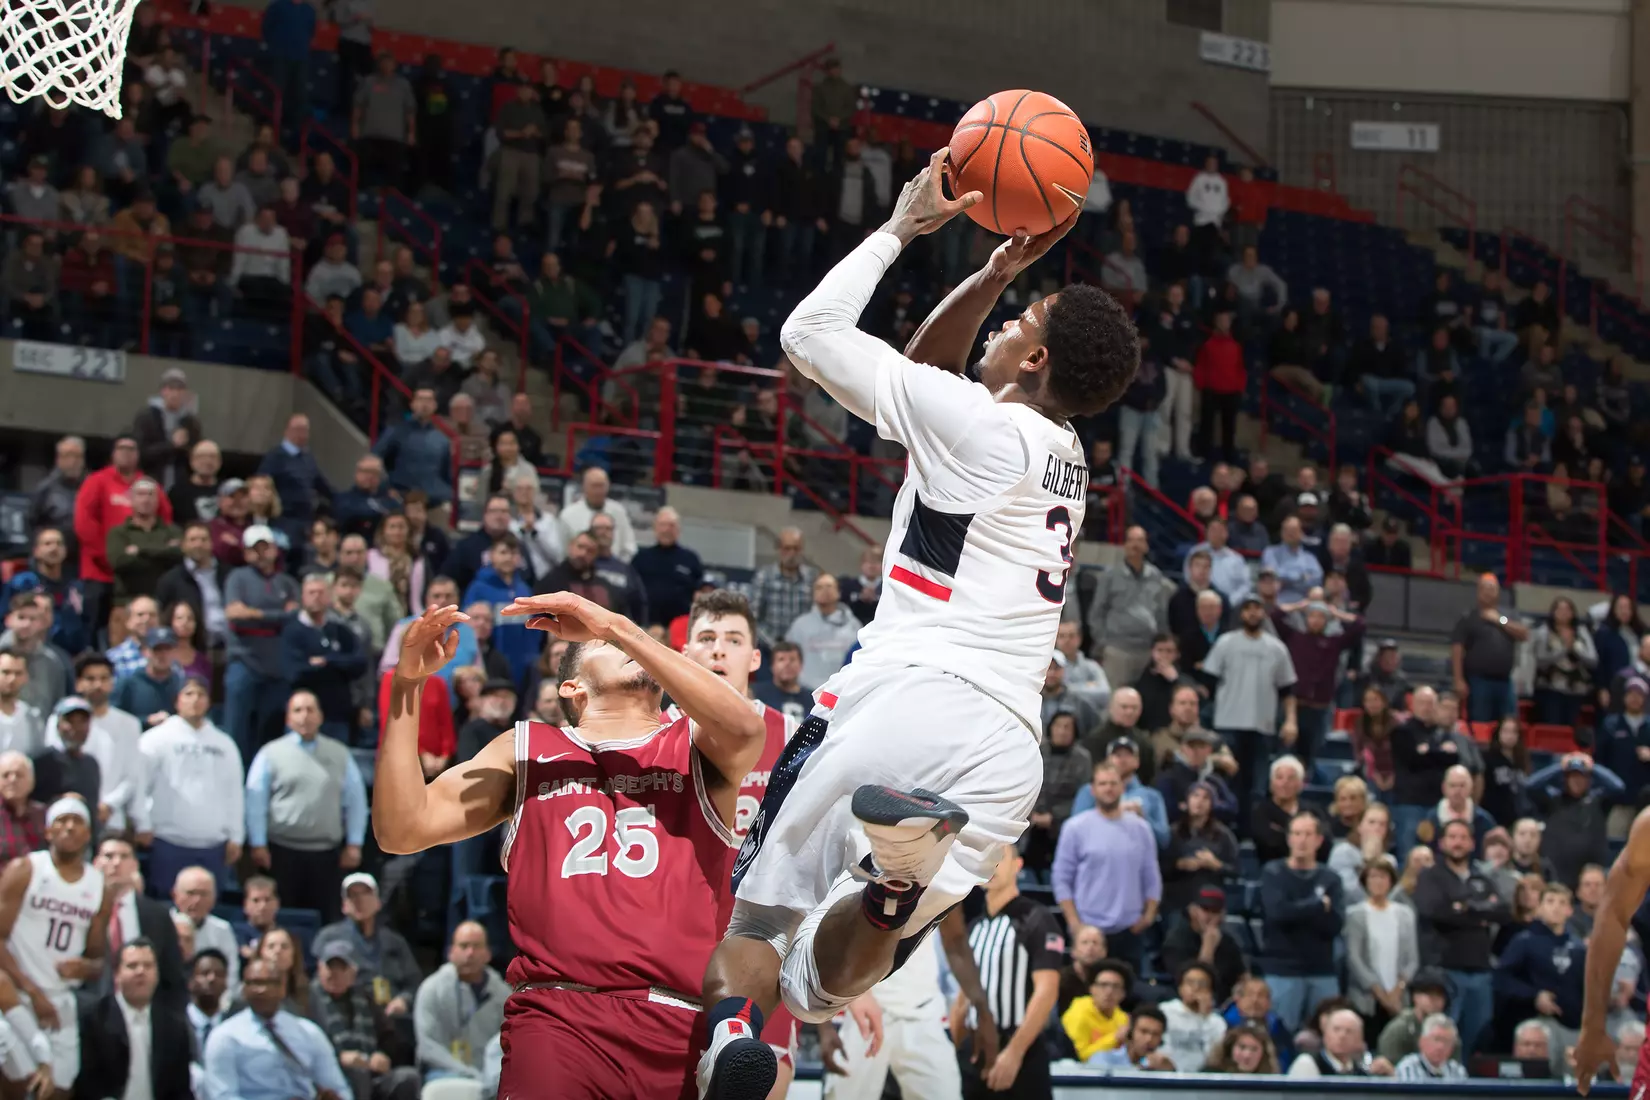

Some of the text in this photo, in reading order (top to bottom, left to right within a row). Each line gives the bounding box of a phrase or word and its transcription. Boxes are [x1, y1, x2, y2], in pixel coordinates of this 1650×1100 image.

[71, 346, 124, 381] 221
[1036, 505, 1073, 604] 3
[537, 777, 597, 800] SAINT
[561, 803, 660, 879] 25
[46, 917, 74, 952] 10
